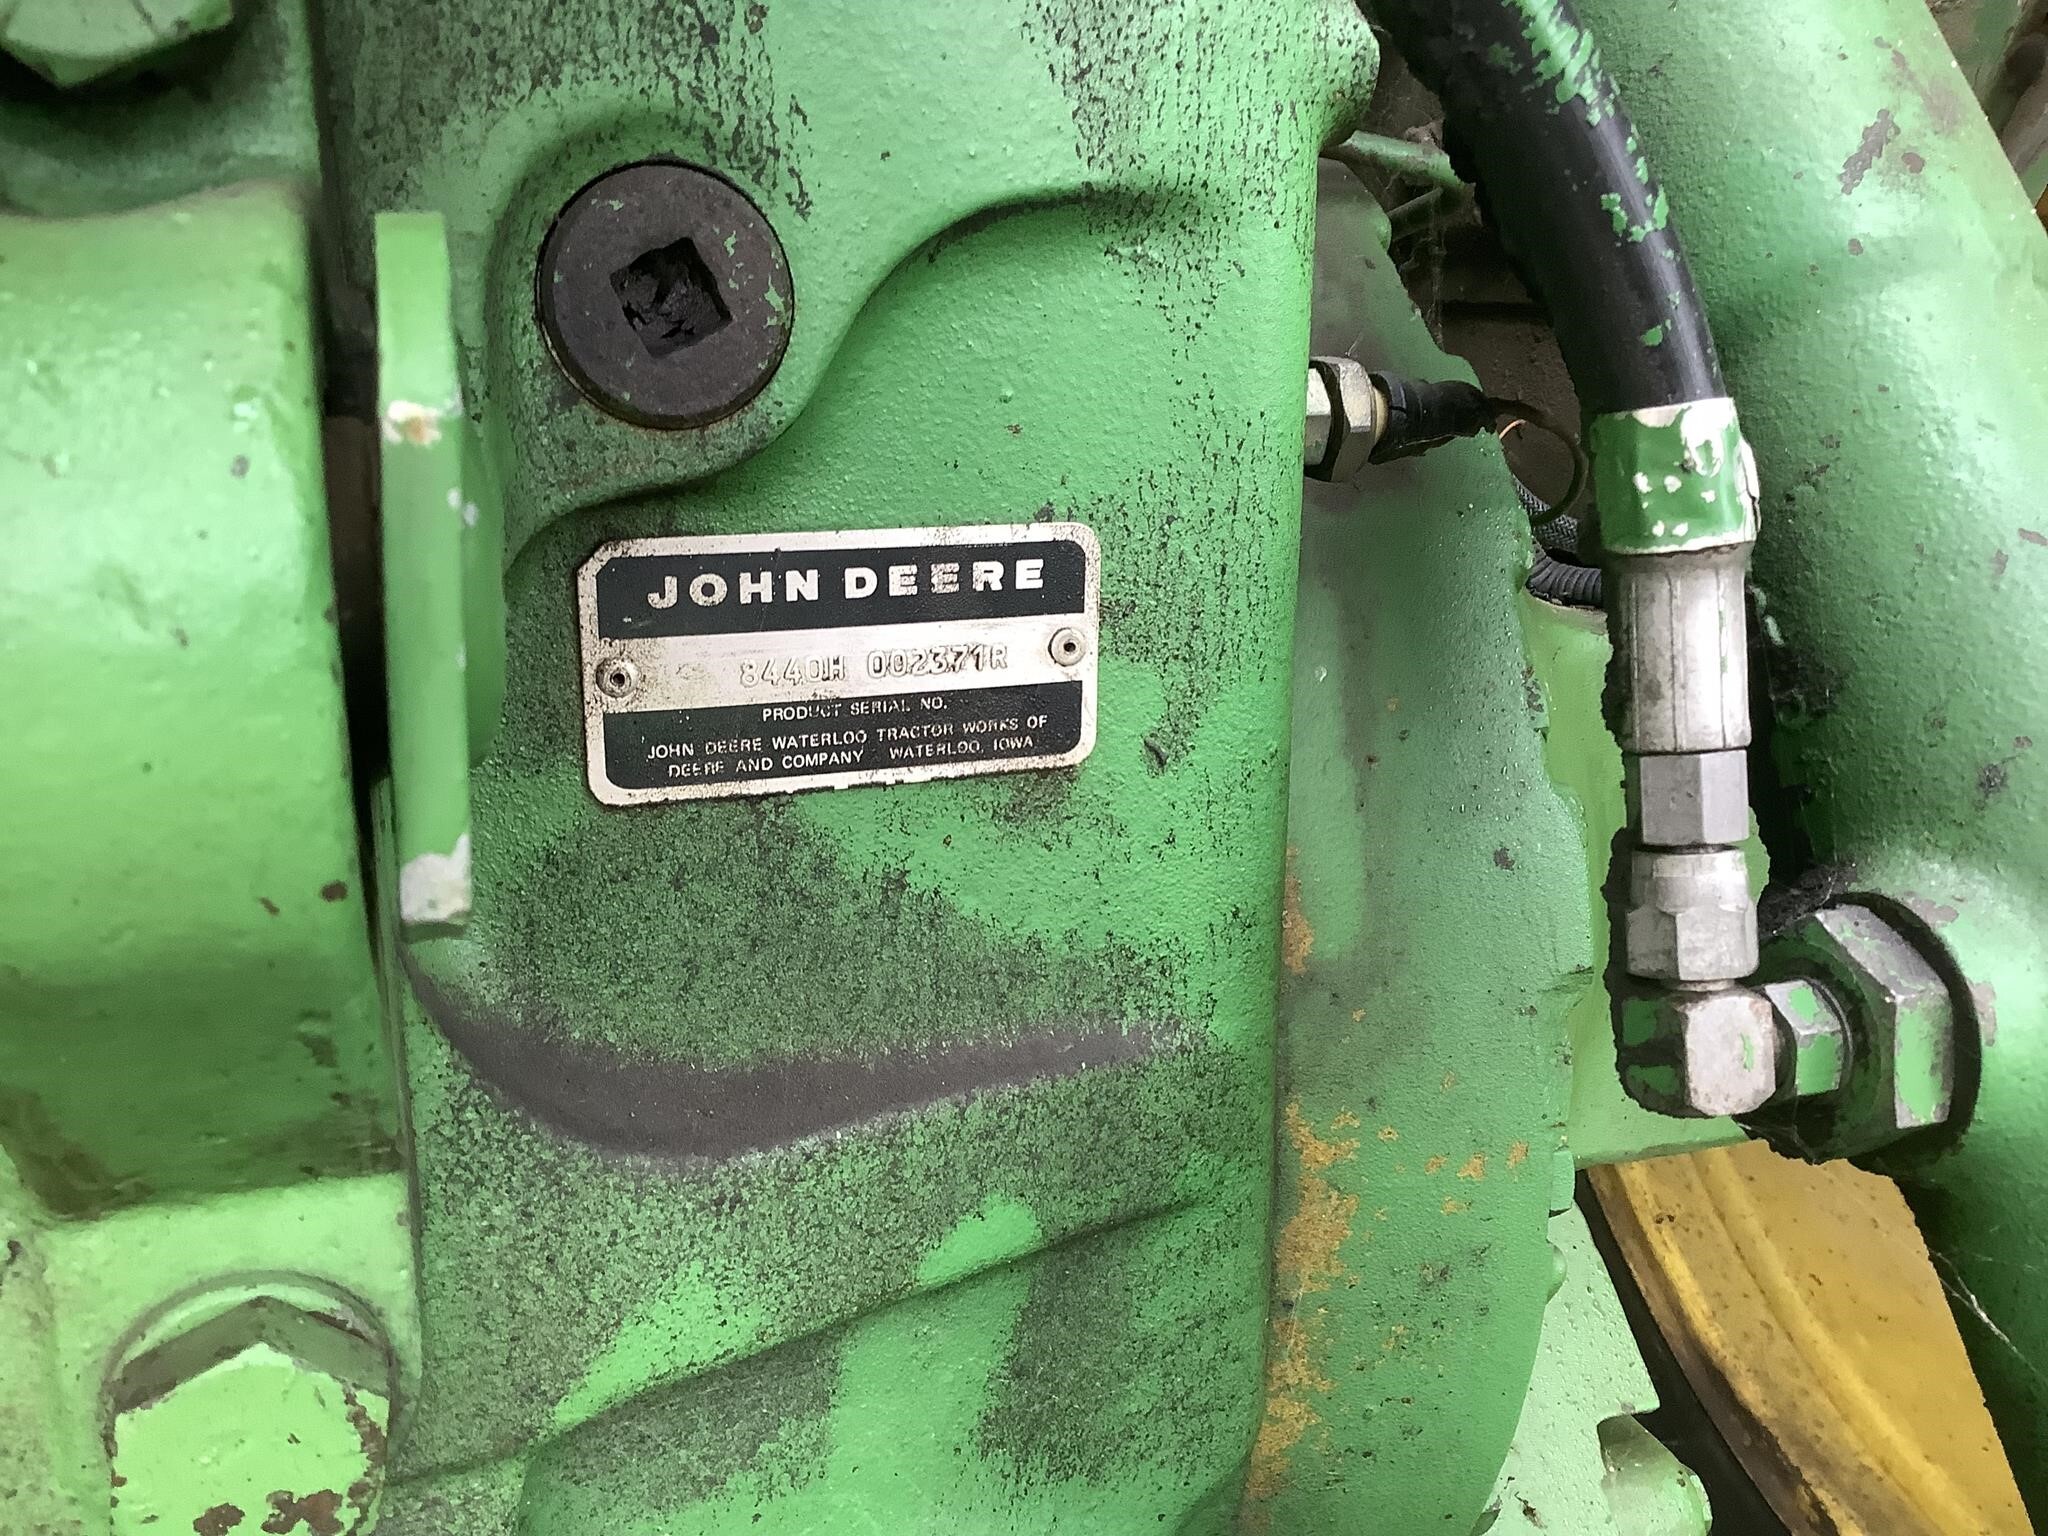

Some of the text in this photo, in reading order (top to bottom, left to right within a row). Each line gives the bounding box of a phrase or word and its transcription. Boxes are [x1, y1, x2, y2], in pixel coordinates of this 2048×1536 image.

[647, 558, 1043, 609] JOHN DEERE
[740, 642, 1008, 687] 8440H 002371R
[762, 696, 948, 722] PRODUCT SERIAL NO.
[647, 714, 1048, 760] JOHN DEERE WATERLOO TRACTOR WORKS OF
[668, 760, 725, 778] DEERE
[735, 756, 773, 774] AND
[782, 749, 864, 770] COMPANY
[993, 735, 1034, 751] IOWA
